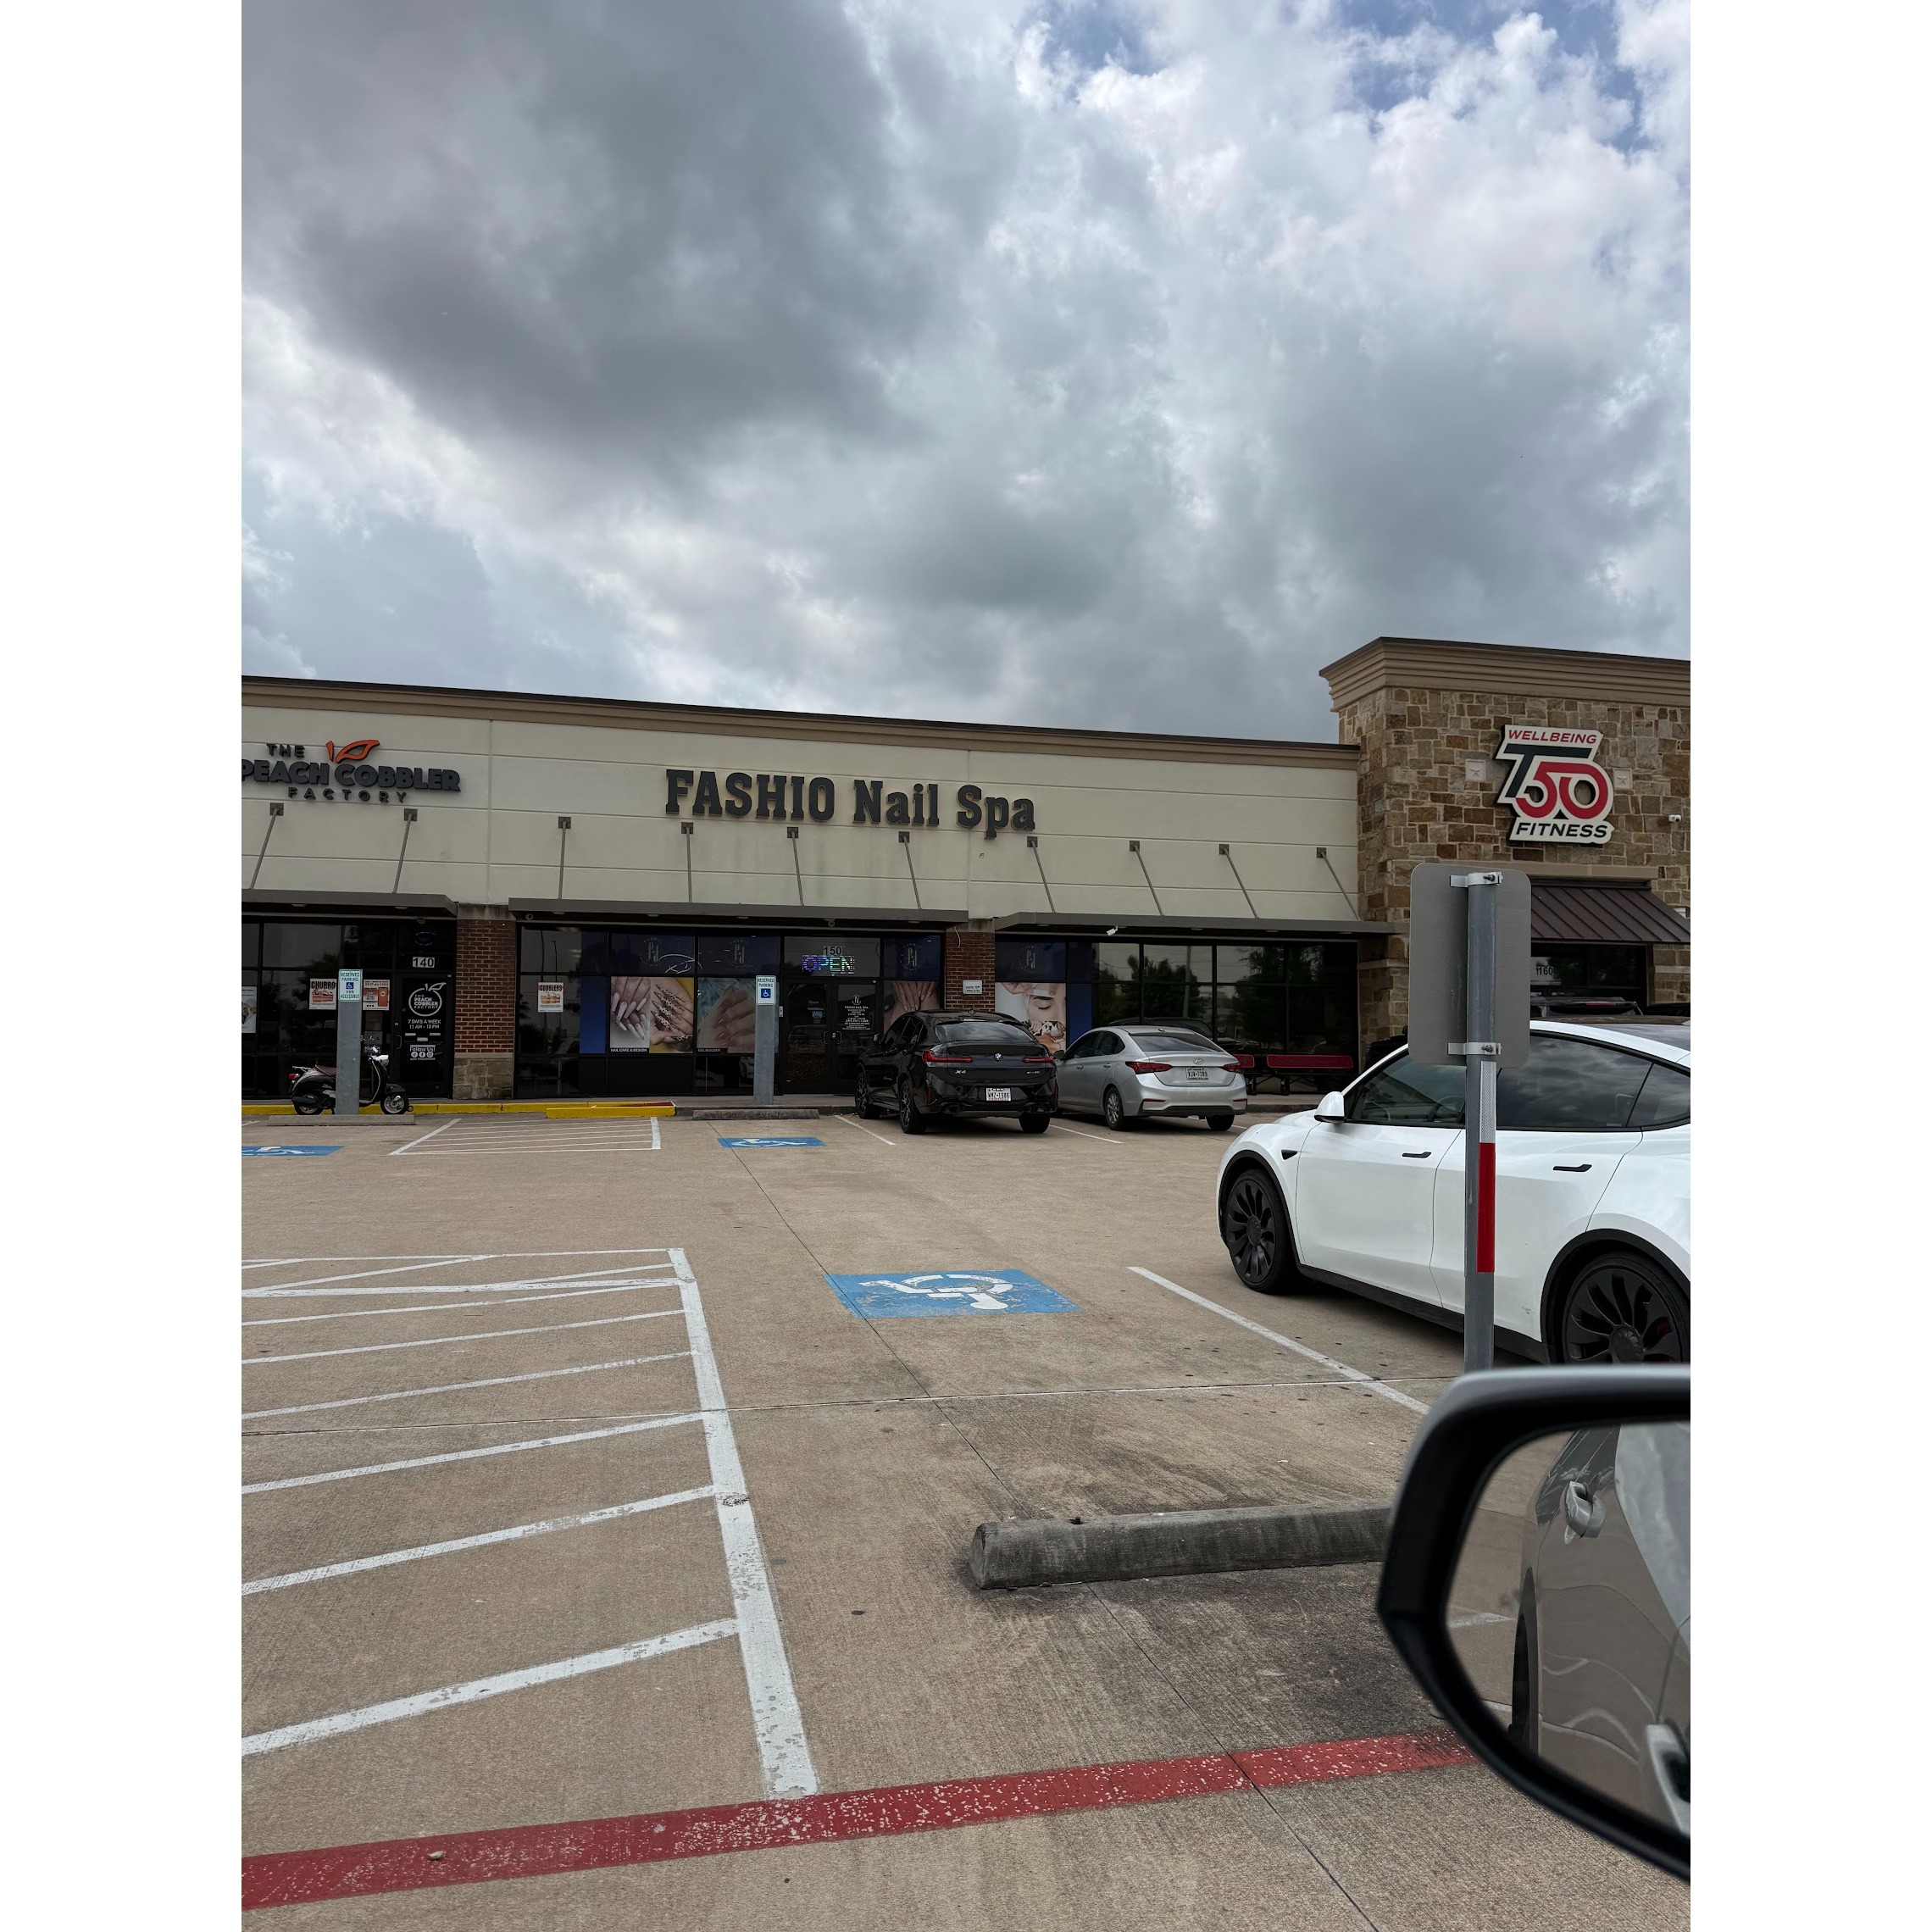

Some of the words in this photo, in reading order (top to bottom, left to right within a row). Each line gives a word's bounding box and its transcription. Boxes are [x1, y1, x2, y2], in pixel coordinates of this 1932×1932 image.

[1508, 730, 1597, 744] WELLBEING
[266, 742, 305, 758] THE
[242, 759, 330, 786] PEACH
[335, 763, 461, 793] COBBLER
[1503, 743, 1609, 819] T50
[288, 787, 407, 803] FACTORY
[666, 769, 836, 822] FASHIO
[854, 780, 939, 826] Nail
[957, 784, 1035, 839] Spa
[1516, 822, 1608, 838] FITNESS
[824, 947, 841, 955] 150
[414, 958, 435, 968] 140
[802, 957, 854, 972] OPEN
[311, 980, 336, 990] CHURRO
